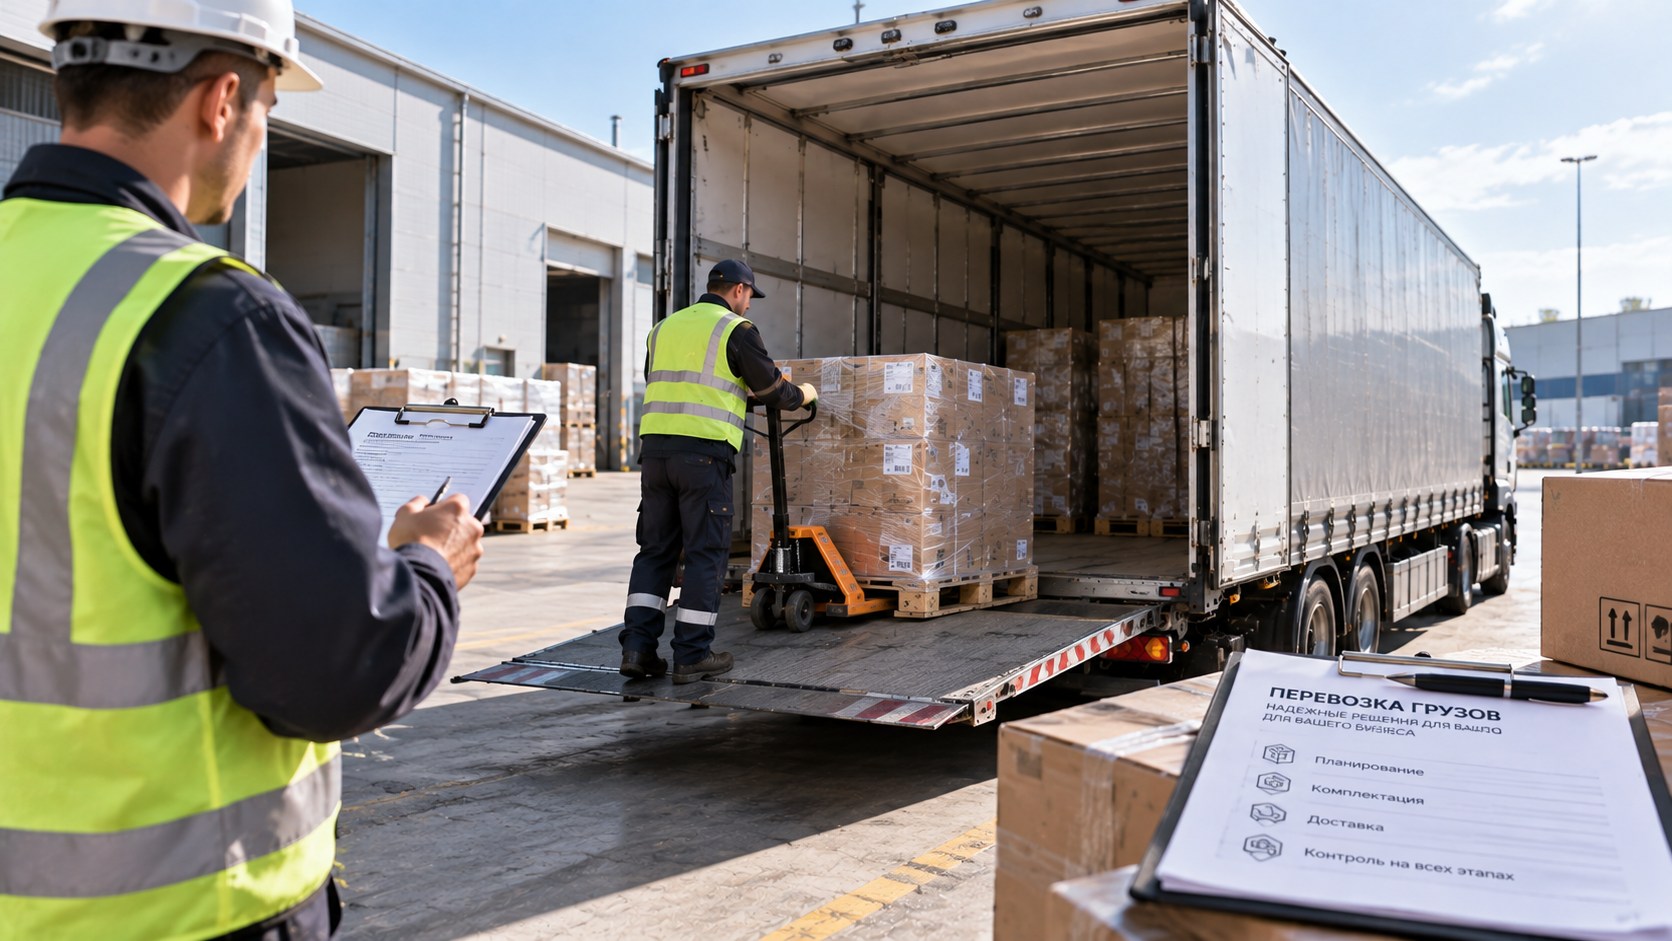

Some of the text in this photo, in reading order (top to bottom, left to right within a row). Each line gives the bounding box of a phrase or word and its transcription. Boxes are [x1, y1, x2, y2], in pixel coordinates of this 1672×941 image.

[1269, 687, 1501, 721] ПЕРЕВОЗКА ГРУЗОВ
[1262, 713, 1292, 723] ДЛЯ
[1294, 717, 1352, 730] ВАШЕГО
[1265, 703, 1347, 719] НАДЕЖНЫЕ
[1421, 720, 1451, 730] ДЛЯ
[1314, 756, 1425, 777] Планирование
[1311, 784, 1425, 806] Комплектация
[1306, 814, 1385, 833] Доставка
[1304, 847, 1515, 881] Контроль на всех этапах
